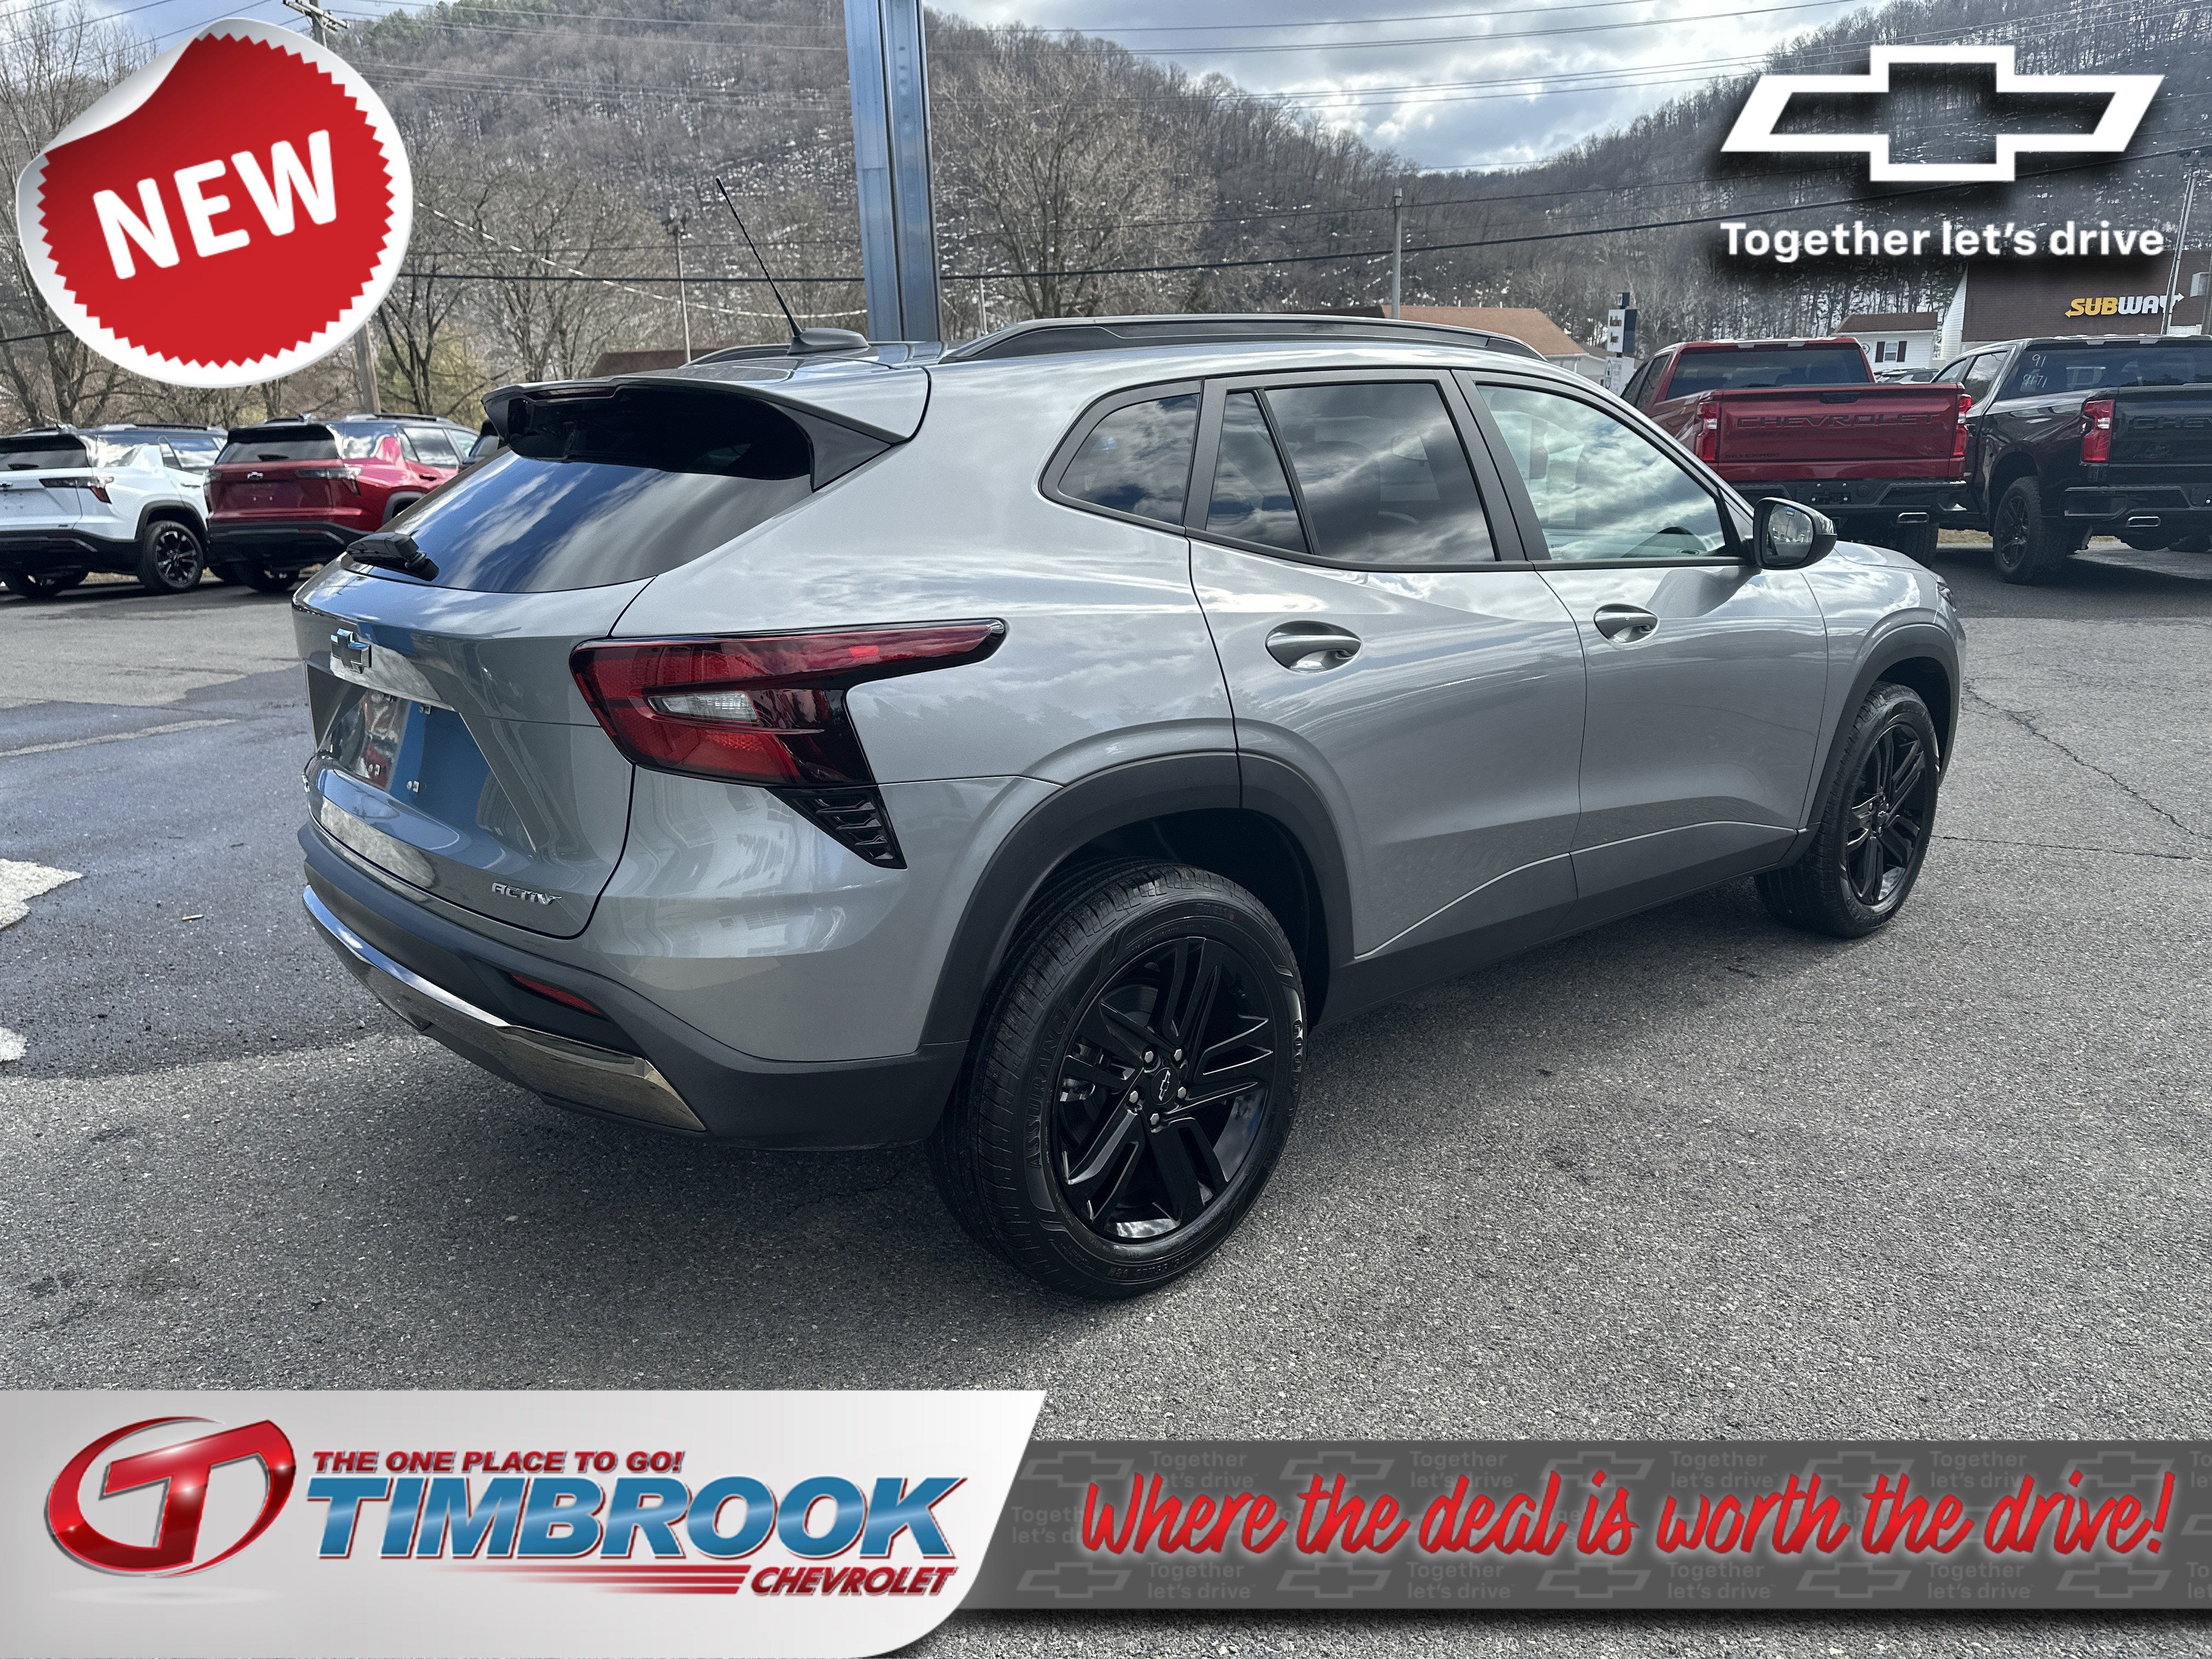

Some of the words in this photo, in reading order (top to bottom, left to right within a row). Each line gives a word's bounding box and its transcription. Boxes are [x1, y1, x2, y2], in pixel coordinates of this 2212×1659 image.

[2065, 292, 2185, 318] SUBWAY
[2032, 354, 2046, 367] 91
[2023, 374, 2047, 388] 9171
[1736, 413, 1940, 430] CHEVROLET
[492, 882, 563, 905] ACTIV
[1026, 996, 1075, 1169] ASSURANCE
